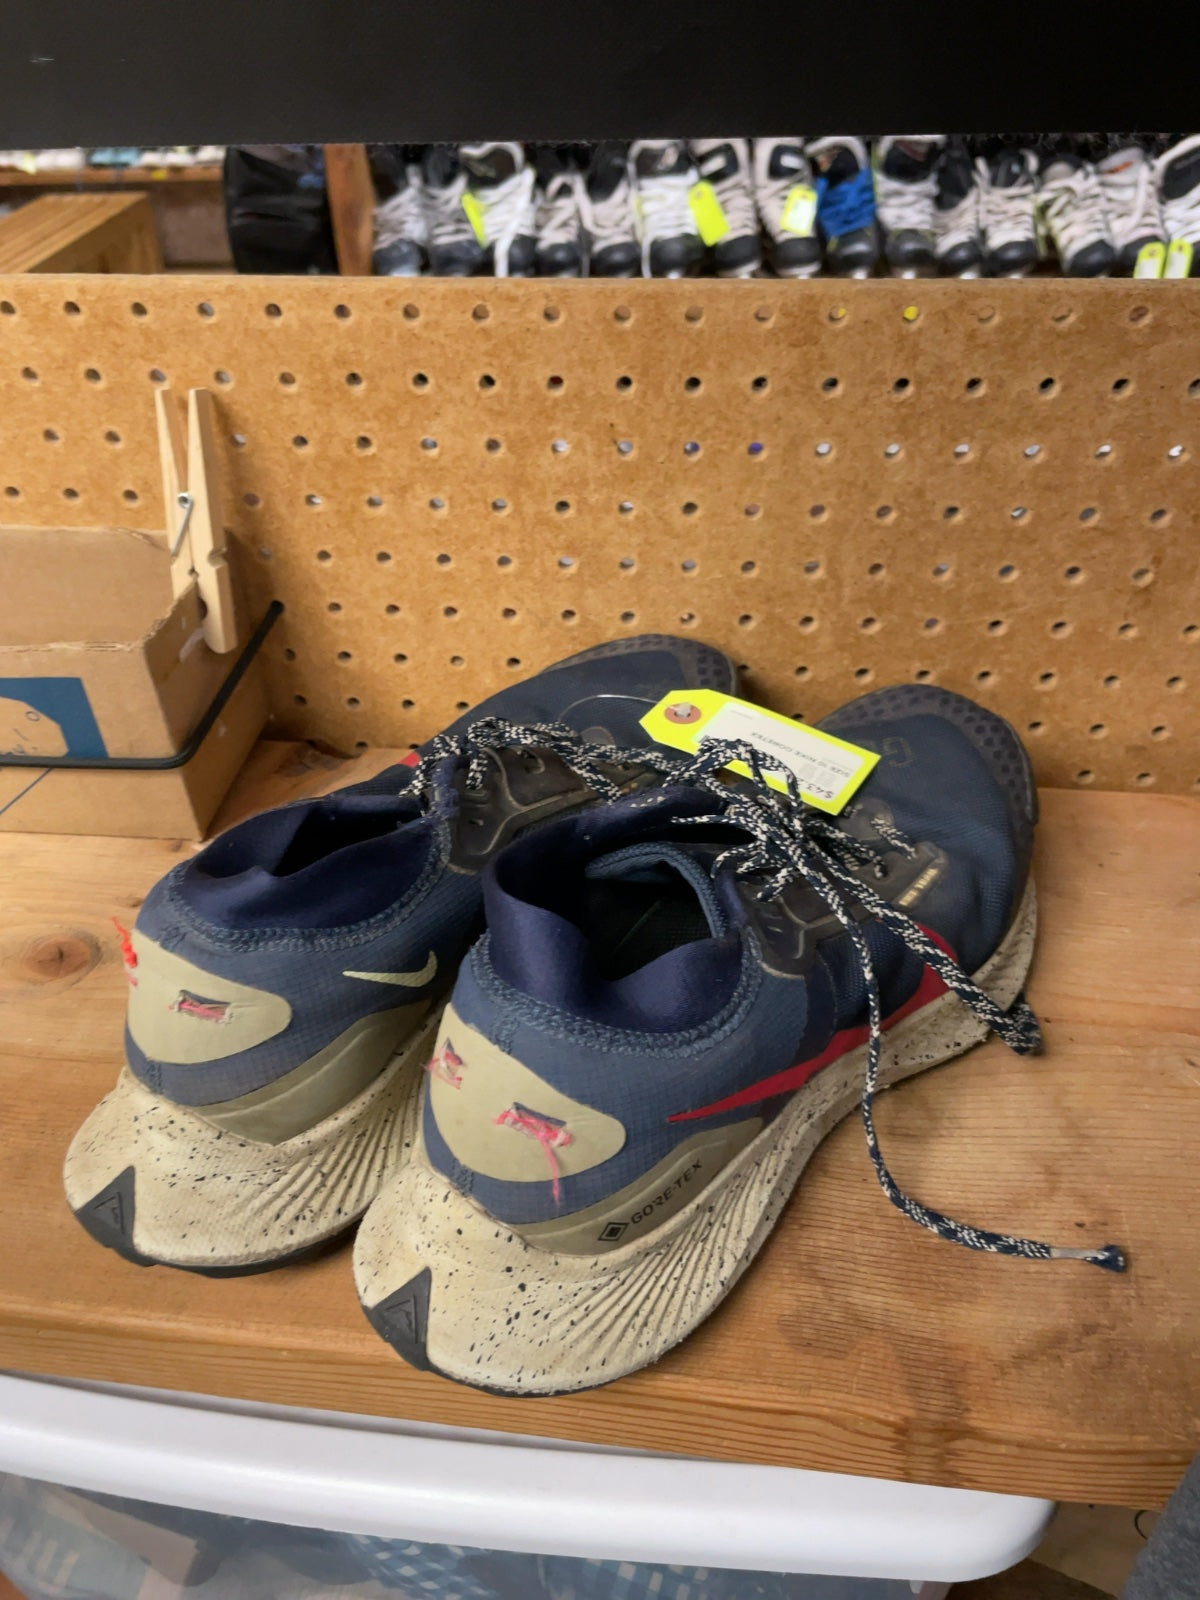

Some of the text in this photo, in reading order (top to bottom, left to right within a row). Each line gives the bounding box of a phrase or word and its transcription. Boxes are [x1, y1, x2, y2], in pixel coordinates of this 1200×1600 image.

[795, 751, 817, 763] NIKE
[796, 776, 834, 799] $43.2
[631, 1159, 702, 1224] GORE-TEX
